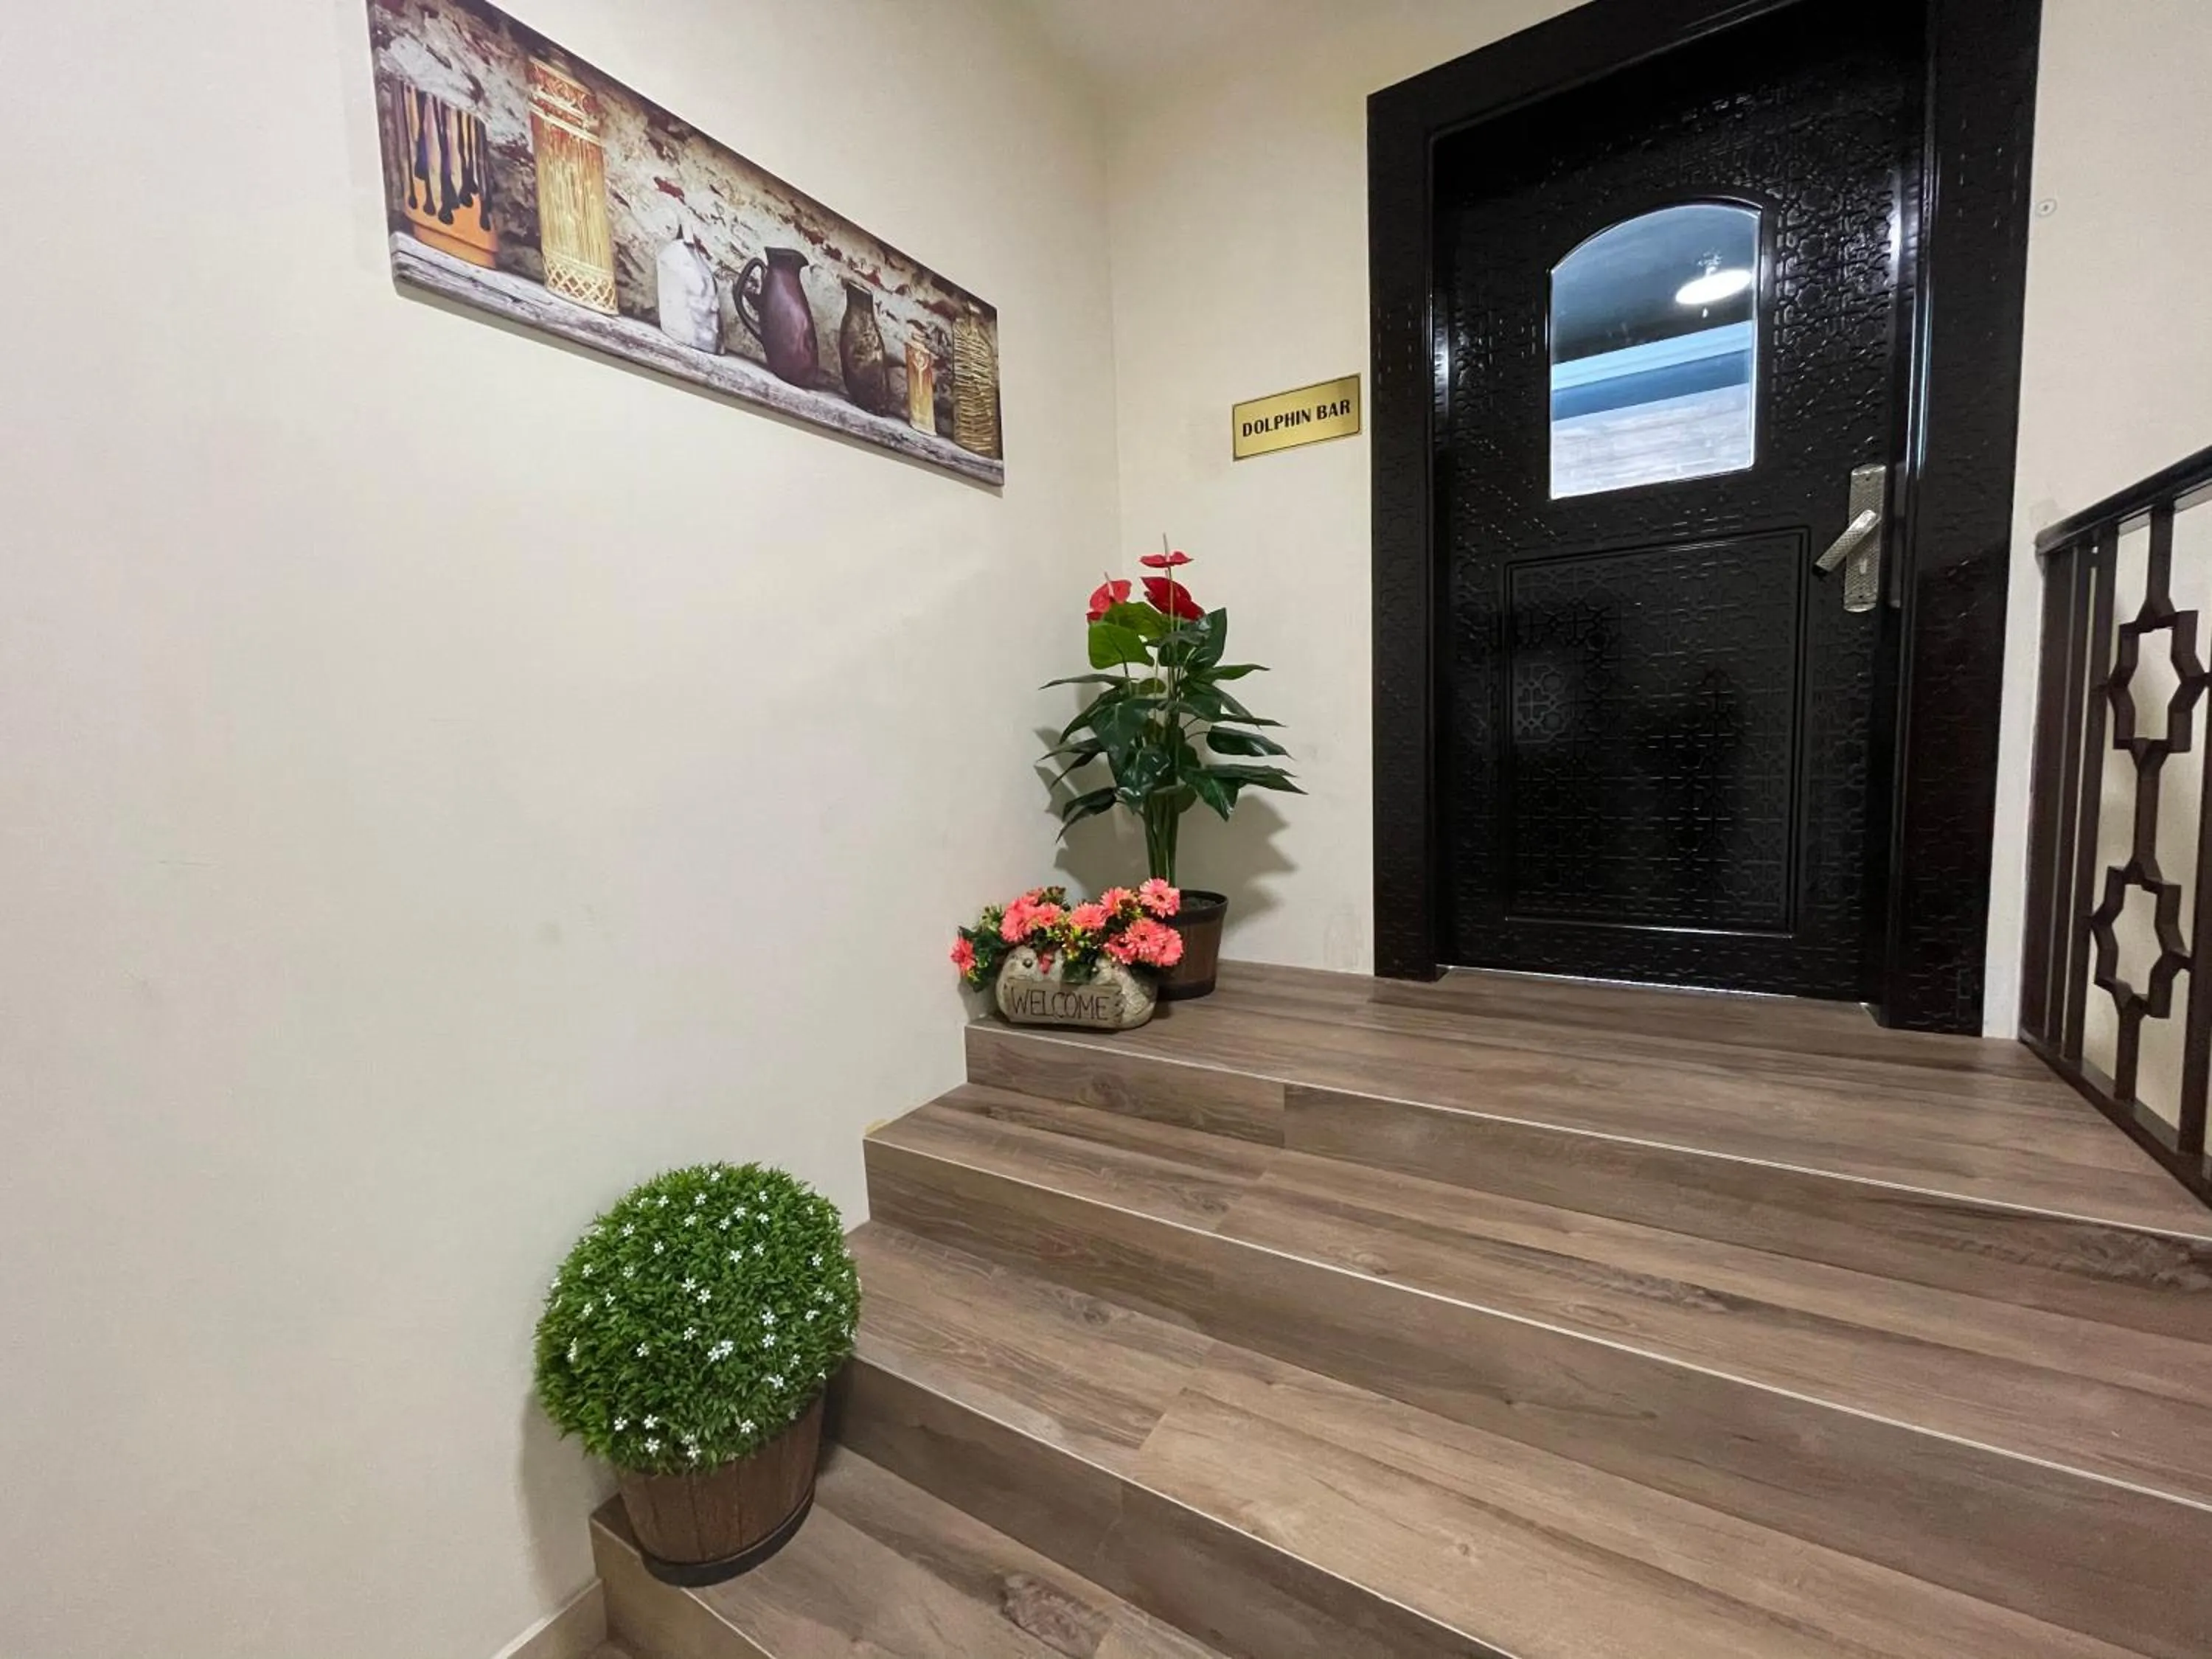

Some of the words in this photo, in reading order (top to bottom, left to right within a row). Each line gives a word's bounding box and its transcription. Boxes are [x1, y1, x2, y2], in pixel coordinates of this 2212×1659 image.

[1242, 408, 1311, 437] DOLPHIN
[1316, 399, 1351, 420] BAR
[1011, 987, 1110, 1021] WELCOME
